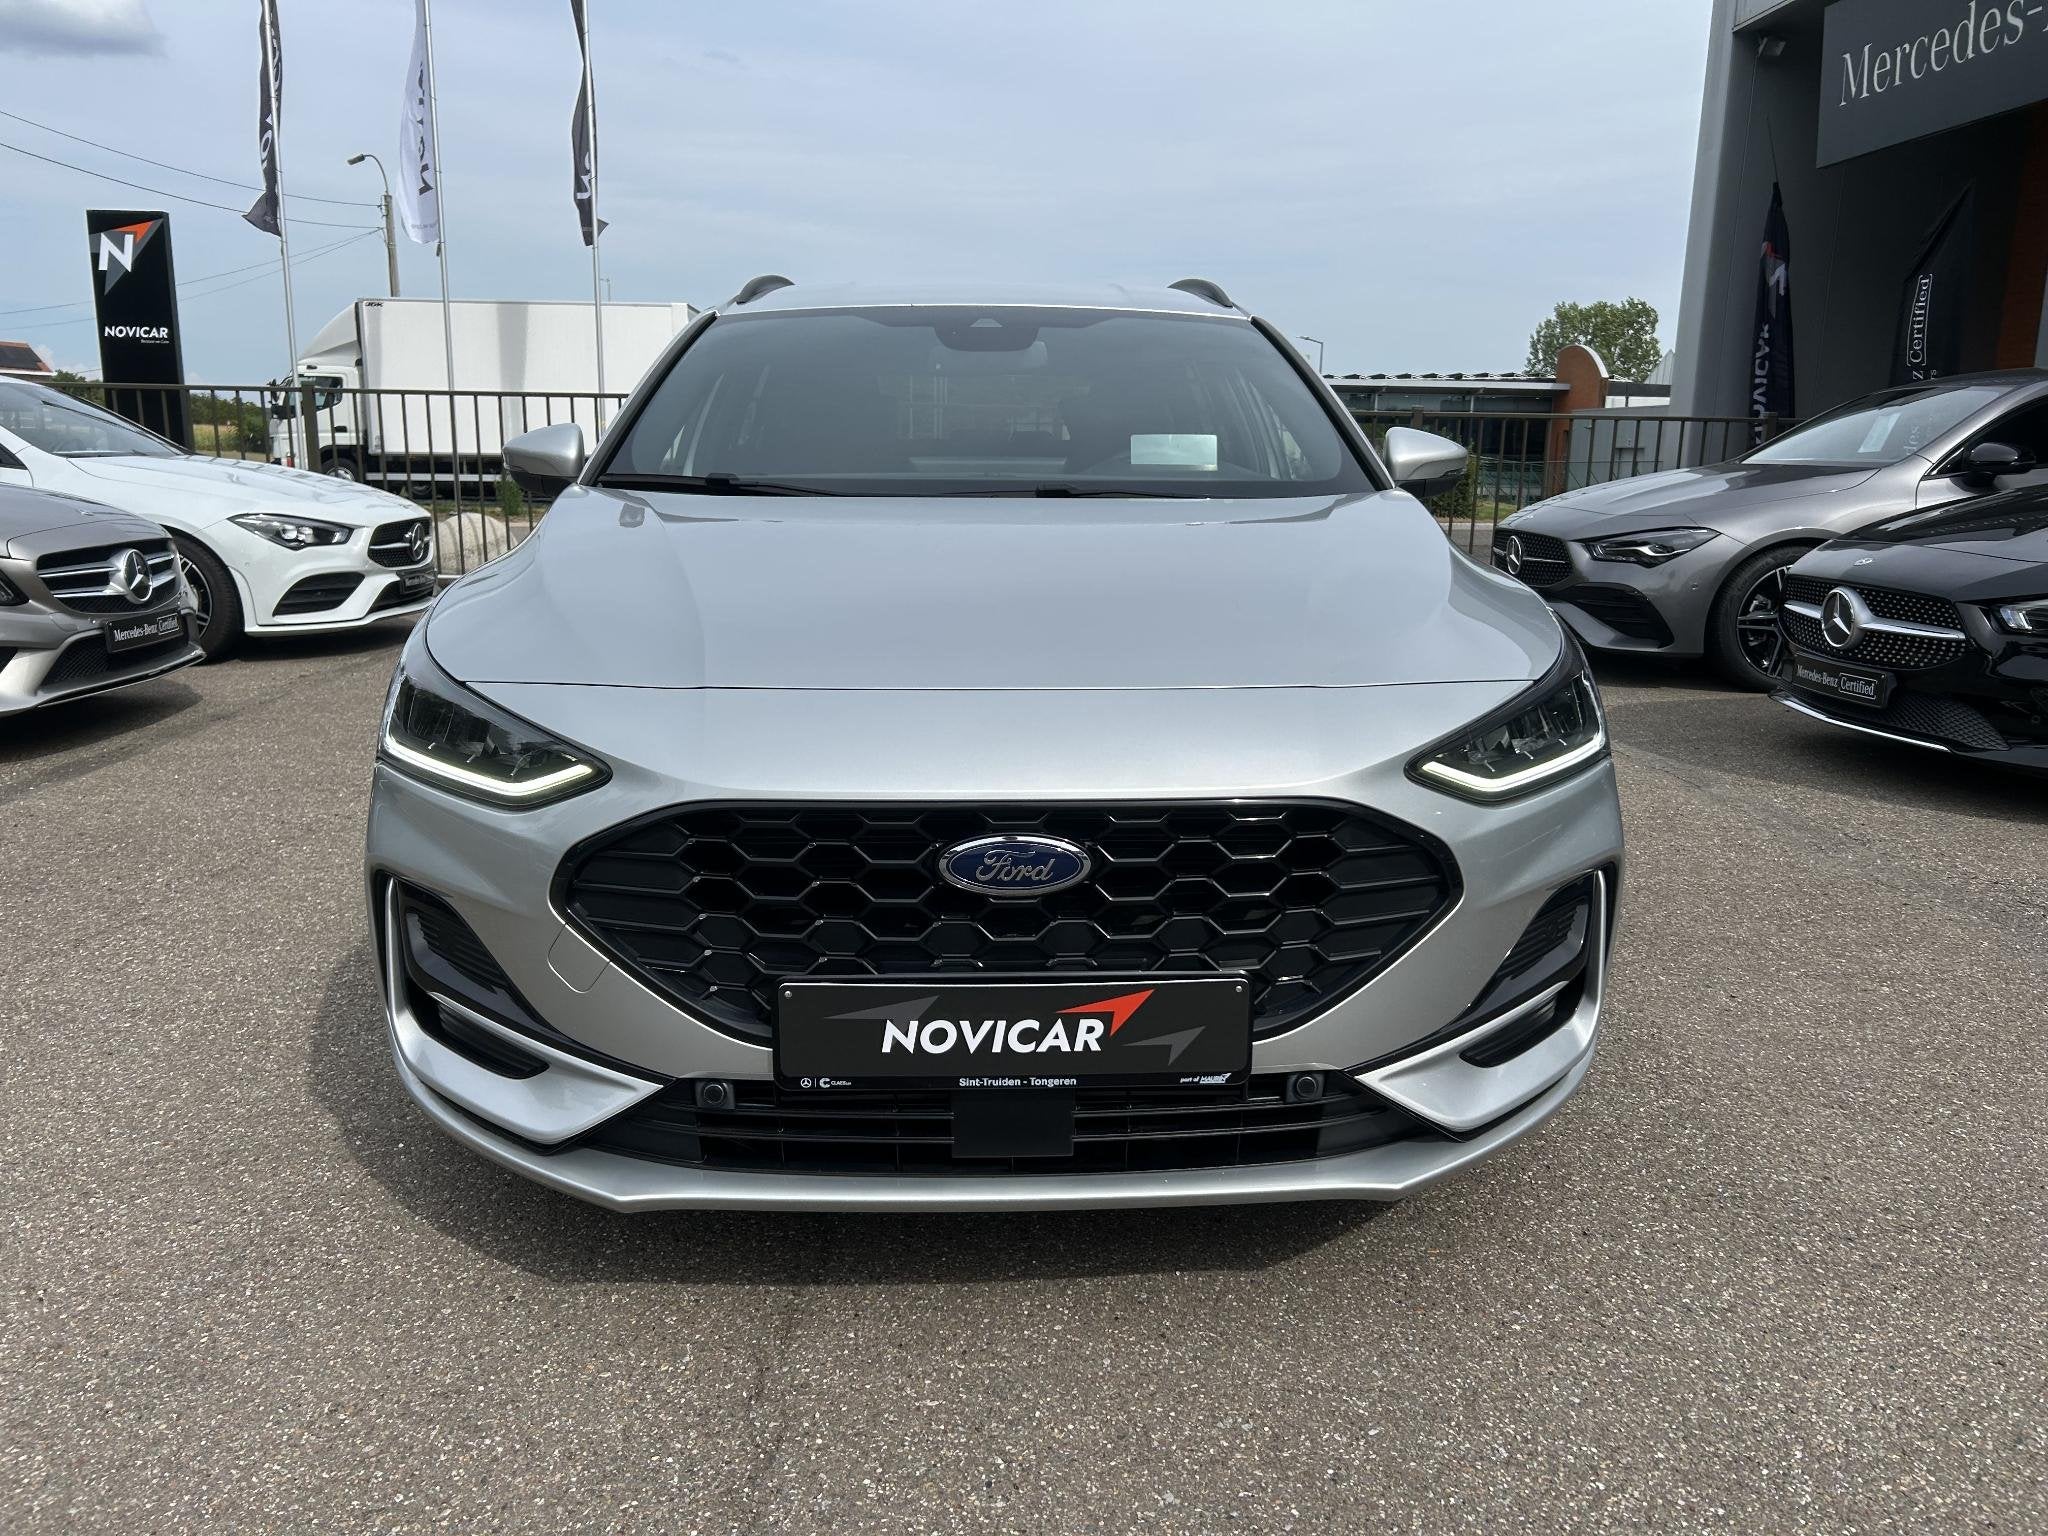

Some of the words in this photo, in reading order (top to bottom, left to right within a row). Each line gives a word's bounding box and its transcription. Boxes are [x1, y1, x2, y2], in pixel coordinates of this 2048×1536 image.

[1839, 0, 2048, 106] Mercedes-
[104, 326, 168, 338] NOVICAR
[1910, 278, 1930, 363] Certified
[114, 623, 157, 641] Mercedes-Benz
[158, 616, 178, 632] Certified
[1796, 664, 1838, 687] Mercedes-Benz
[1840, 676, 1875, 695] Certified
[976, 850, 1056, 881] Ford
[881, 1018, 1105, 1054] NOVICAR
[959, 1077, 1021, 1087] Sint-Truiden
[1029, 1077, 1077, 1088] Tongeren
